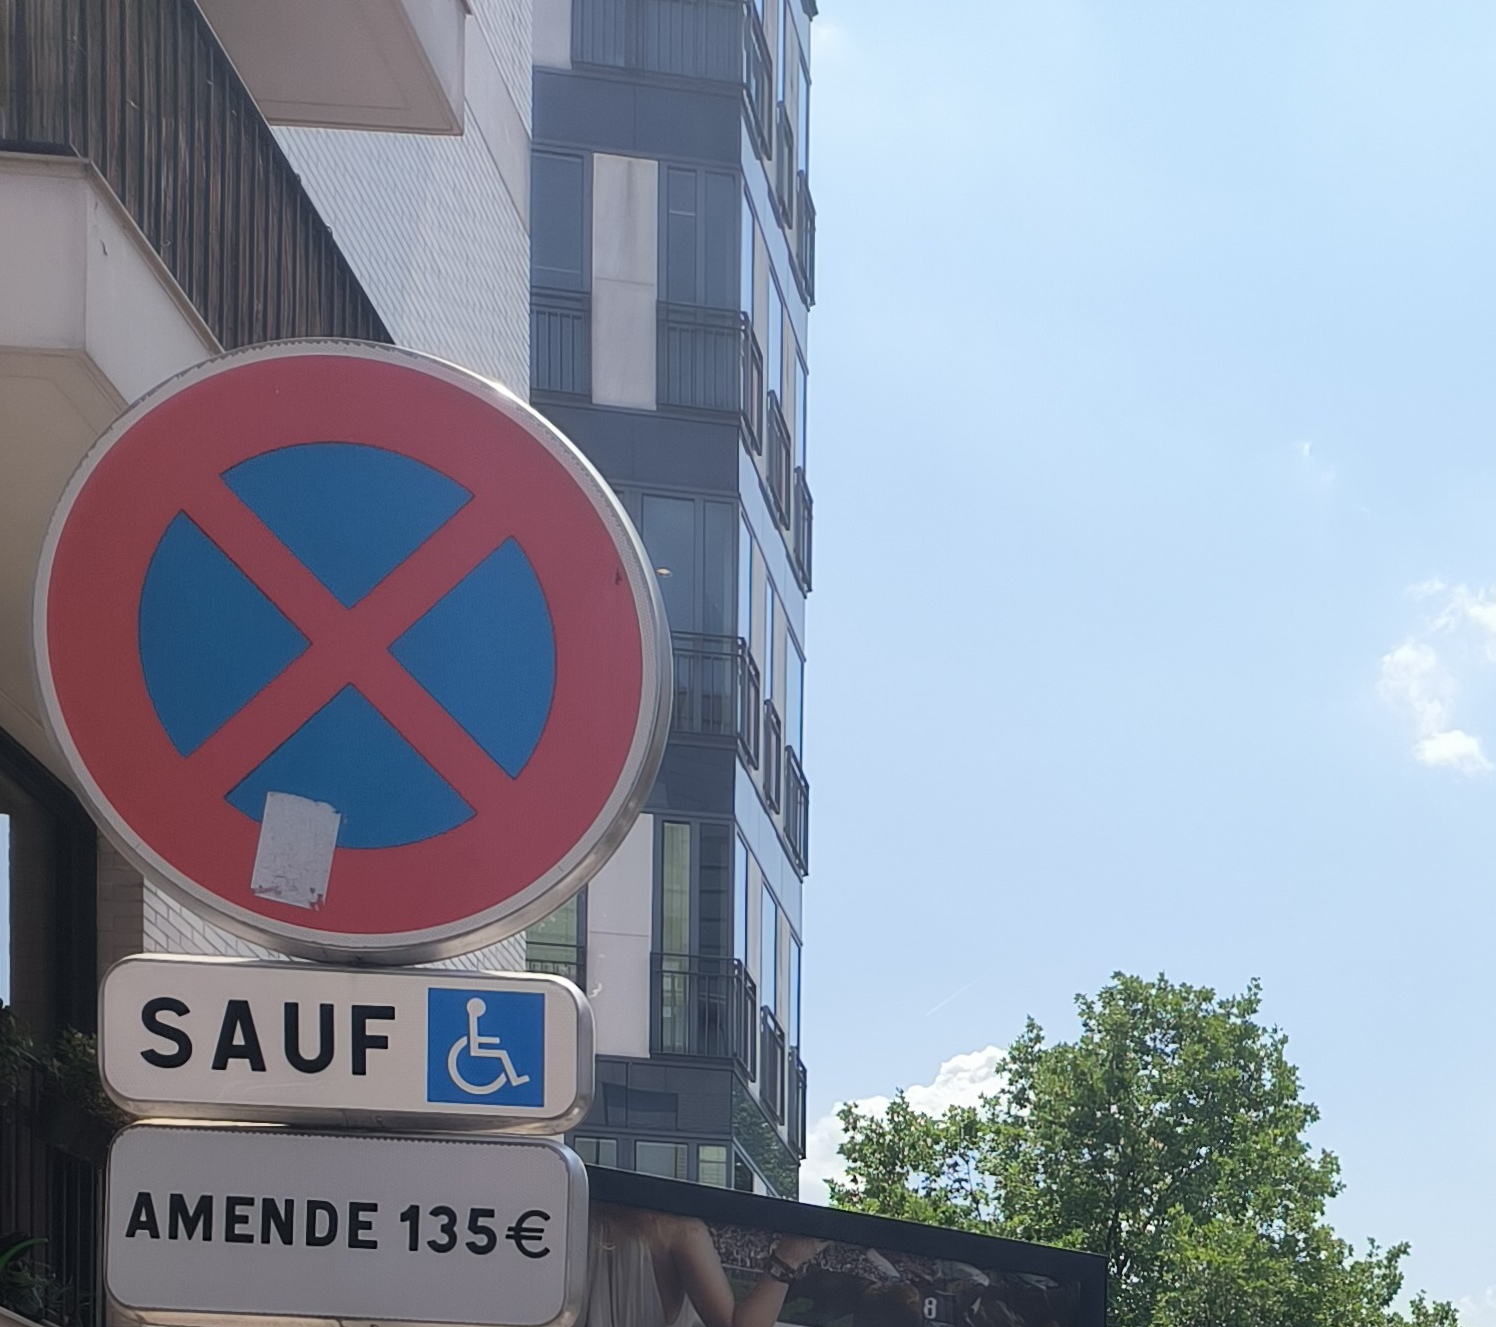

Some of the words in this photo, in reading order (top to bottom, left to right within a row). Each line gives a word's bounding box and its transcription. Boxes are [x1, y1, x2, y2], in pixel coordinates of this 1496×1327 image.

[140, 997, 396, 1076] SAUF
[125, 1191, 379, 1249] AMENDE
[399, 1204, 551, 1259] 135€
